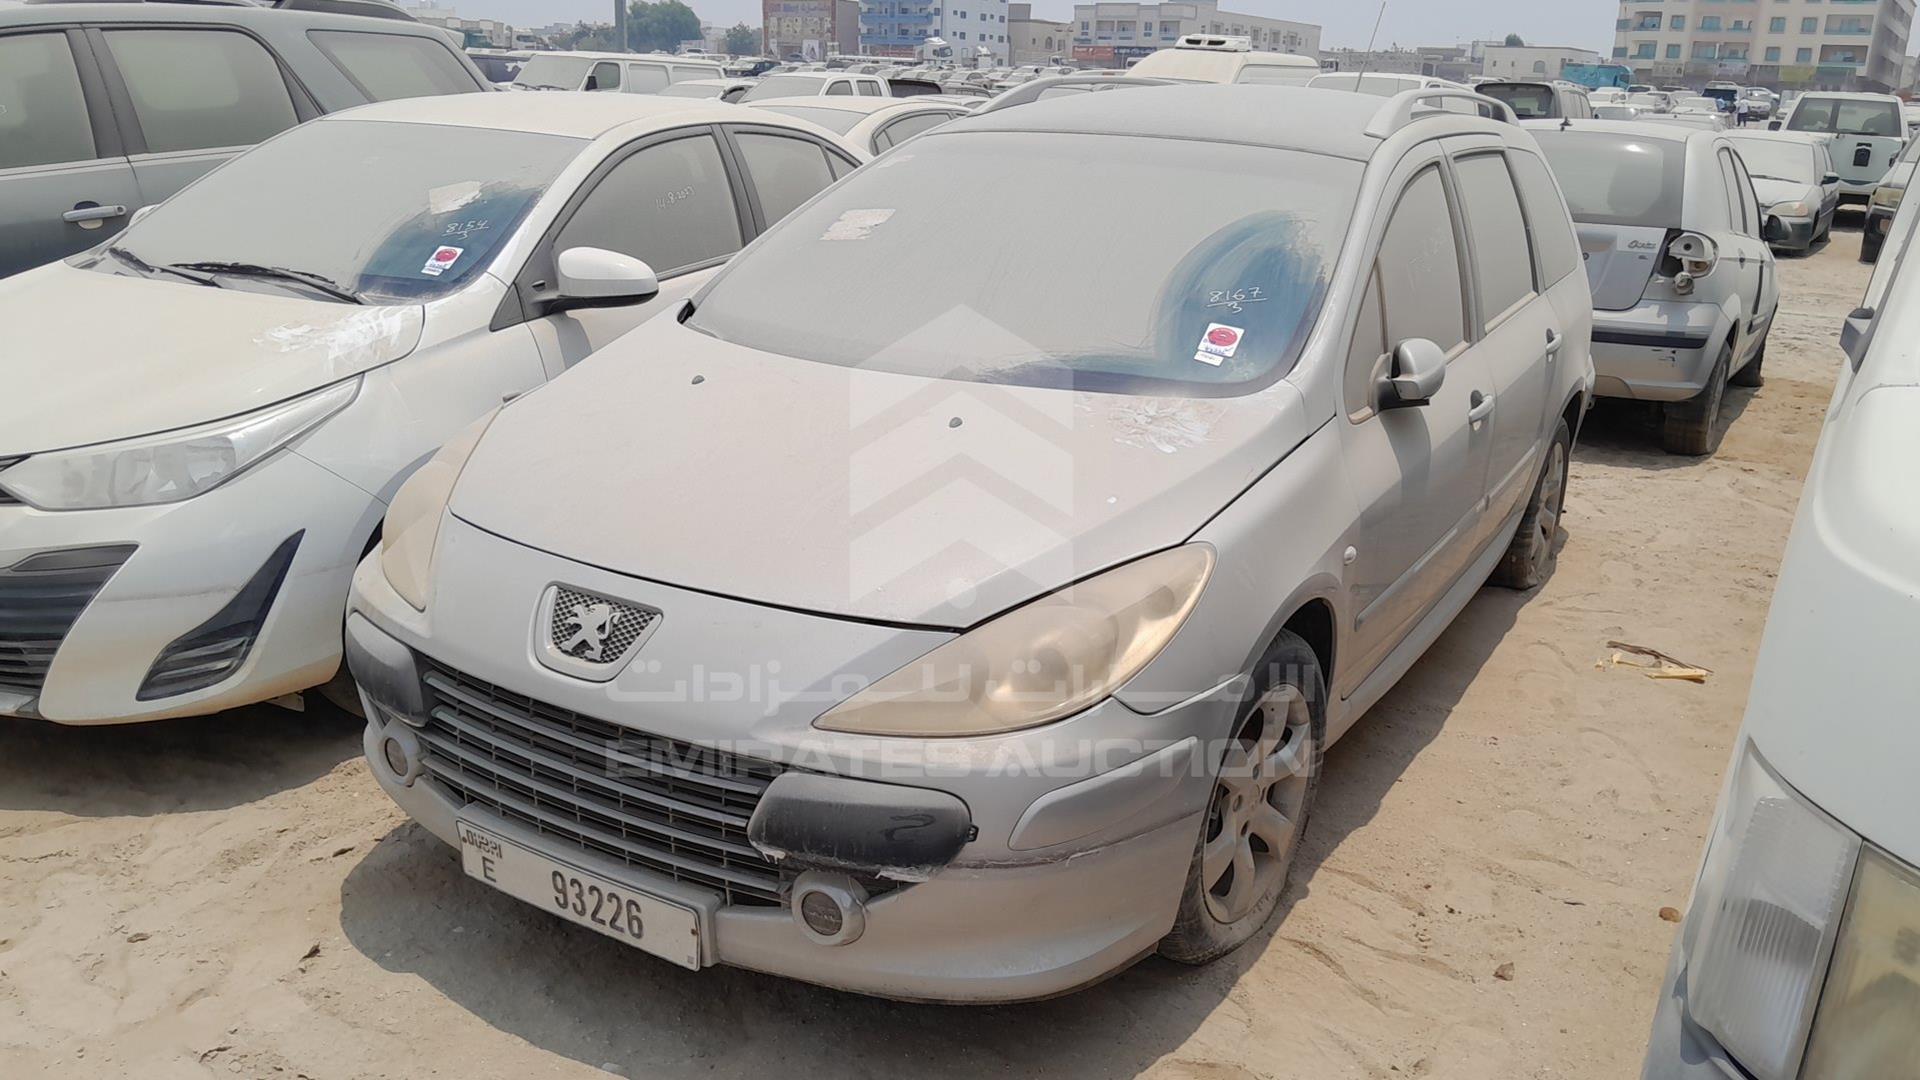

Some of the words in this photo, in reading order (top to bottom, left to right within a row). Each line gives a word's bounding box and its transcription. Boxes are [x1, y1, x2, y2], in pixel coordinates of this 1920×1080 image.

[446, 220, 488, 233] 8154
[1208, 286, 1263, 303] 8167
[1227, 301, 1243, 314] 3
[482, 856, 497, 882] E
[552, 870, 645, 939] 93226
